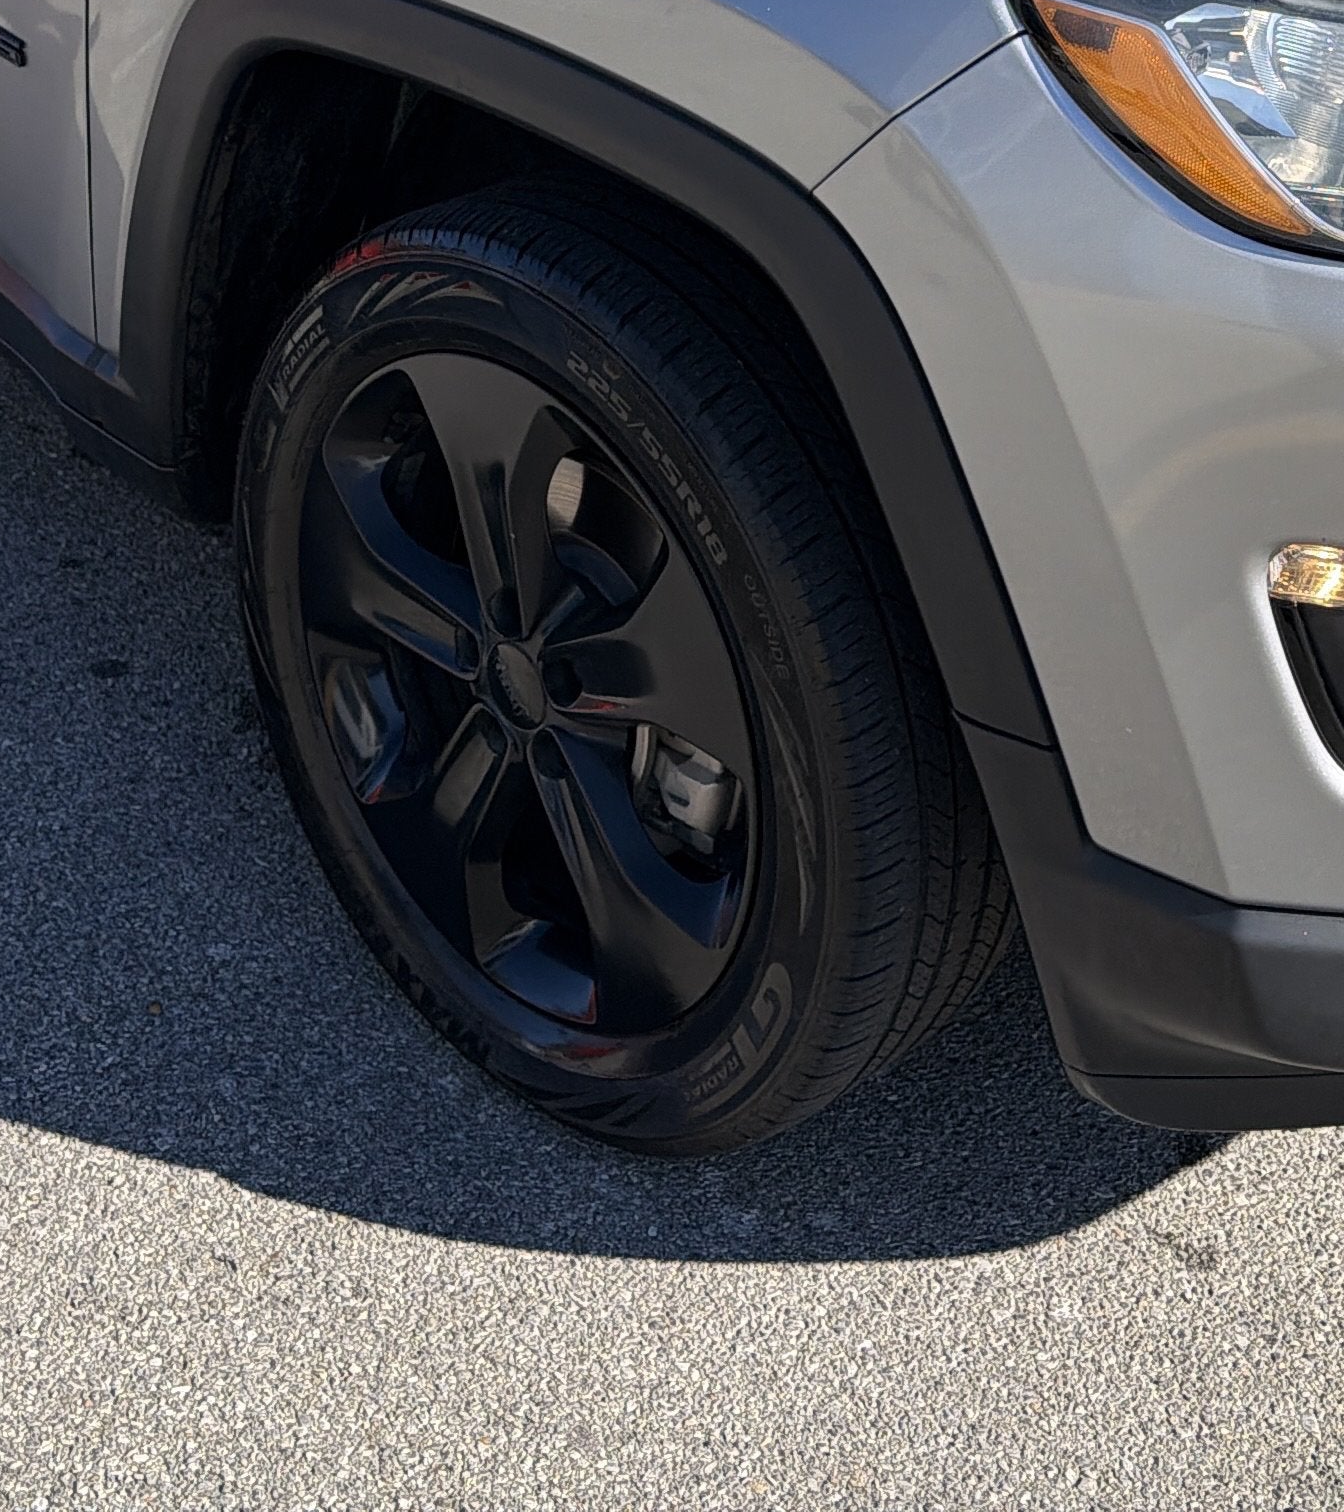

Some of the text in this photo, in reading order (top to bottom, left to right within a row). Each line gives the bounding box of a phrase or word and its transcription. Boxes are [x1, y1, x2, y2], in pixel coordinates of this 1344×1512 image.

[283, 323, 327, 382] RADIAL
[566, 350, 728, 568] 225/55R18
[744, 574, 791, 680] OUTSIDE
